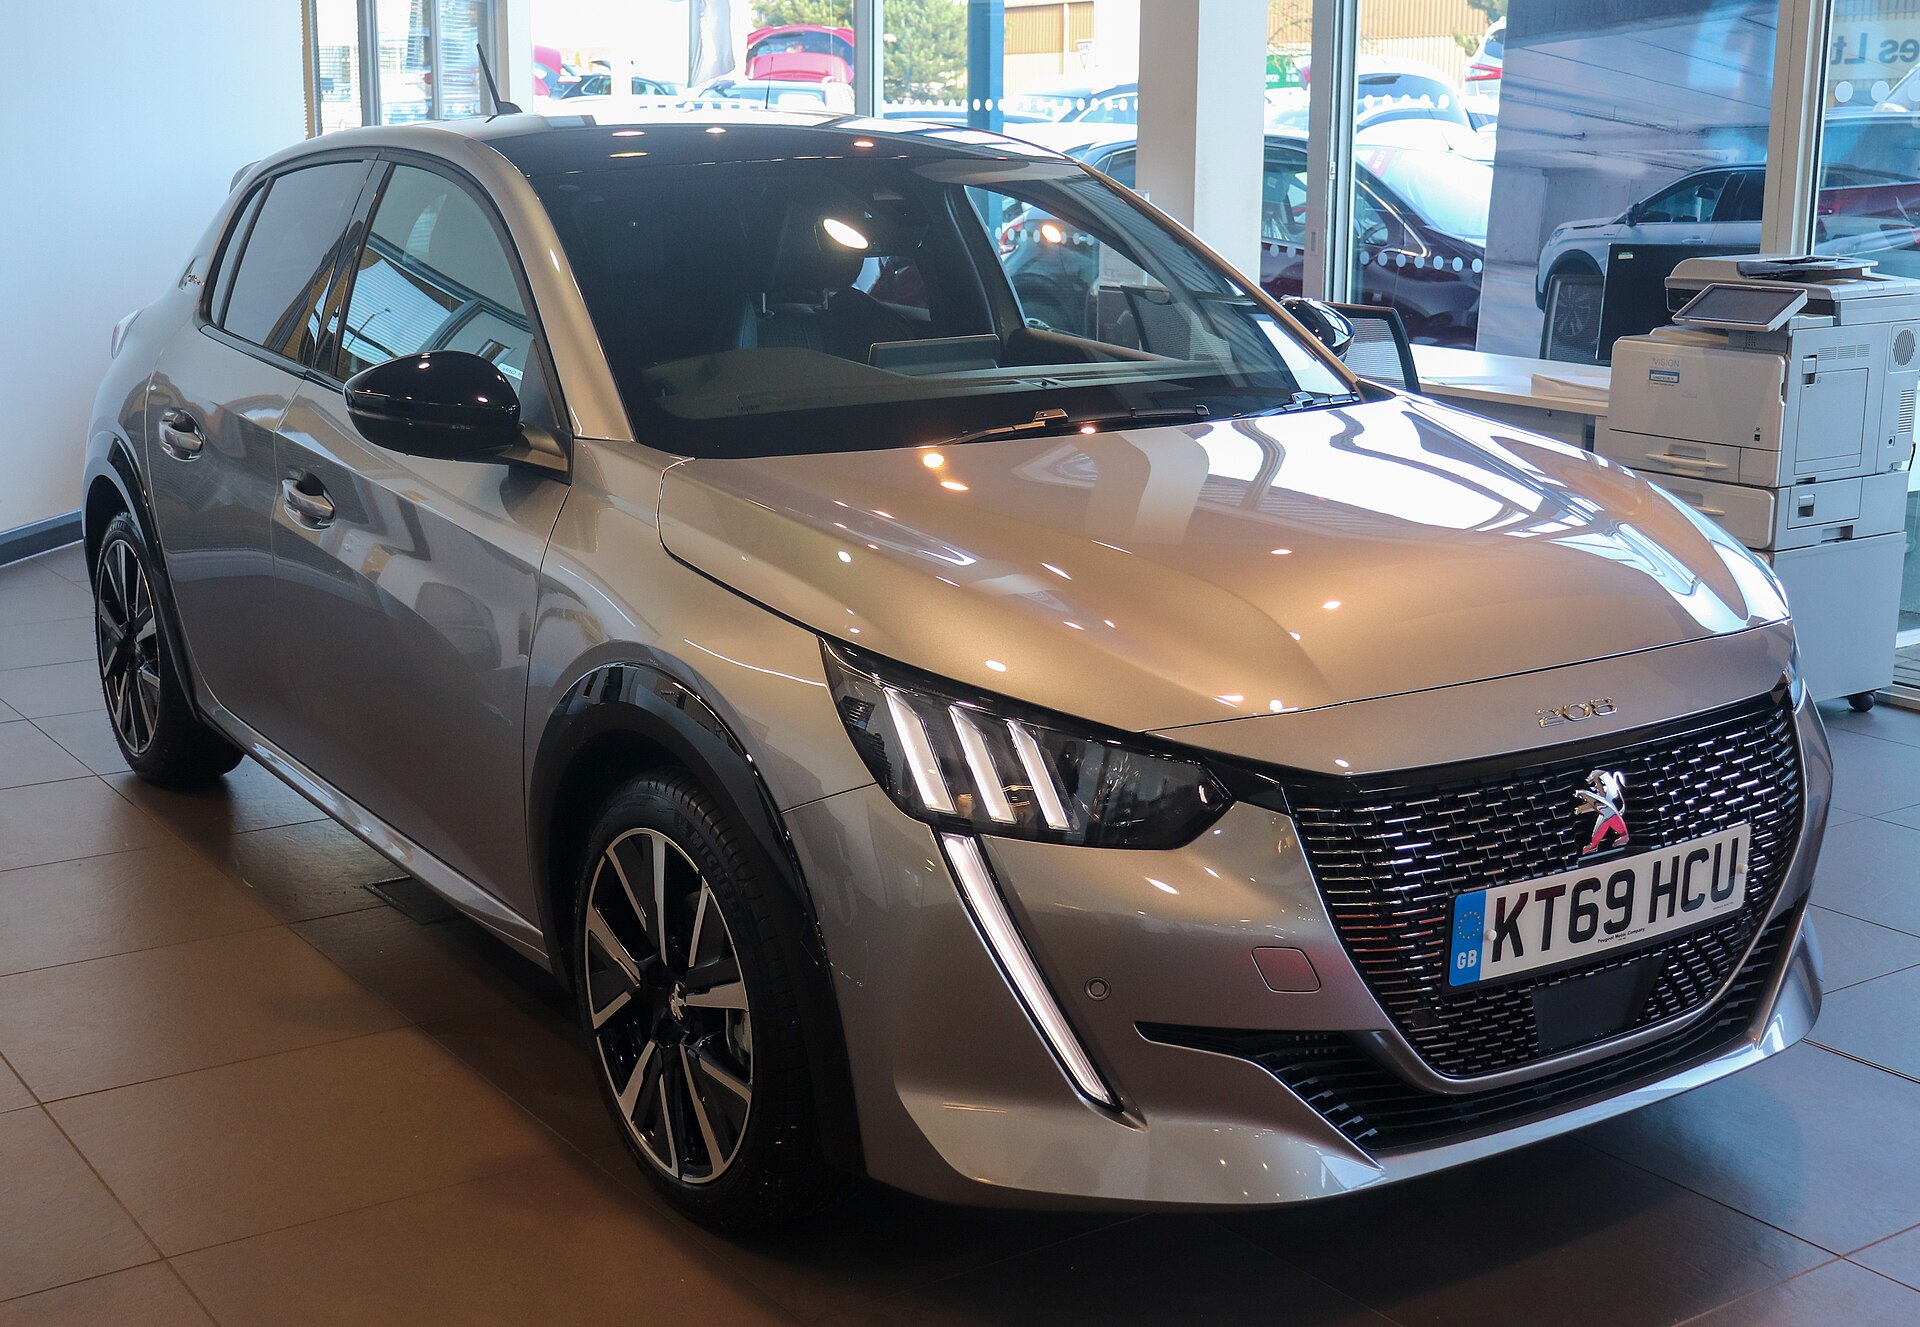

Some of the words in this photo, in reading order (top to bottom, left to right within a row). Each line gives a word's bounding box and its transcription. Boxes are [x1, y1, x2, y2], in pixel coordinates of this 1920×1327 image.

[689, 832, 749, 936] MICHEL
[1491, 869, 1636, 963] KT69
[1648, 837, 1739, 924] HCU
[1456, 949, 1477, 970] GB
